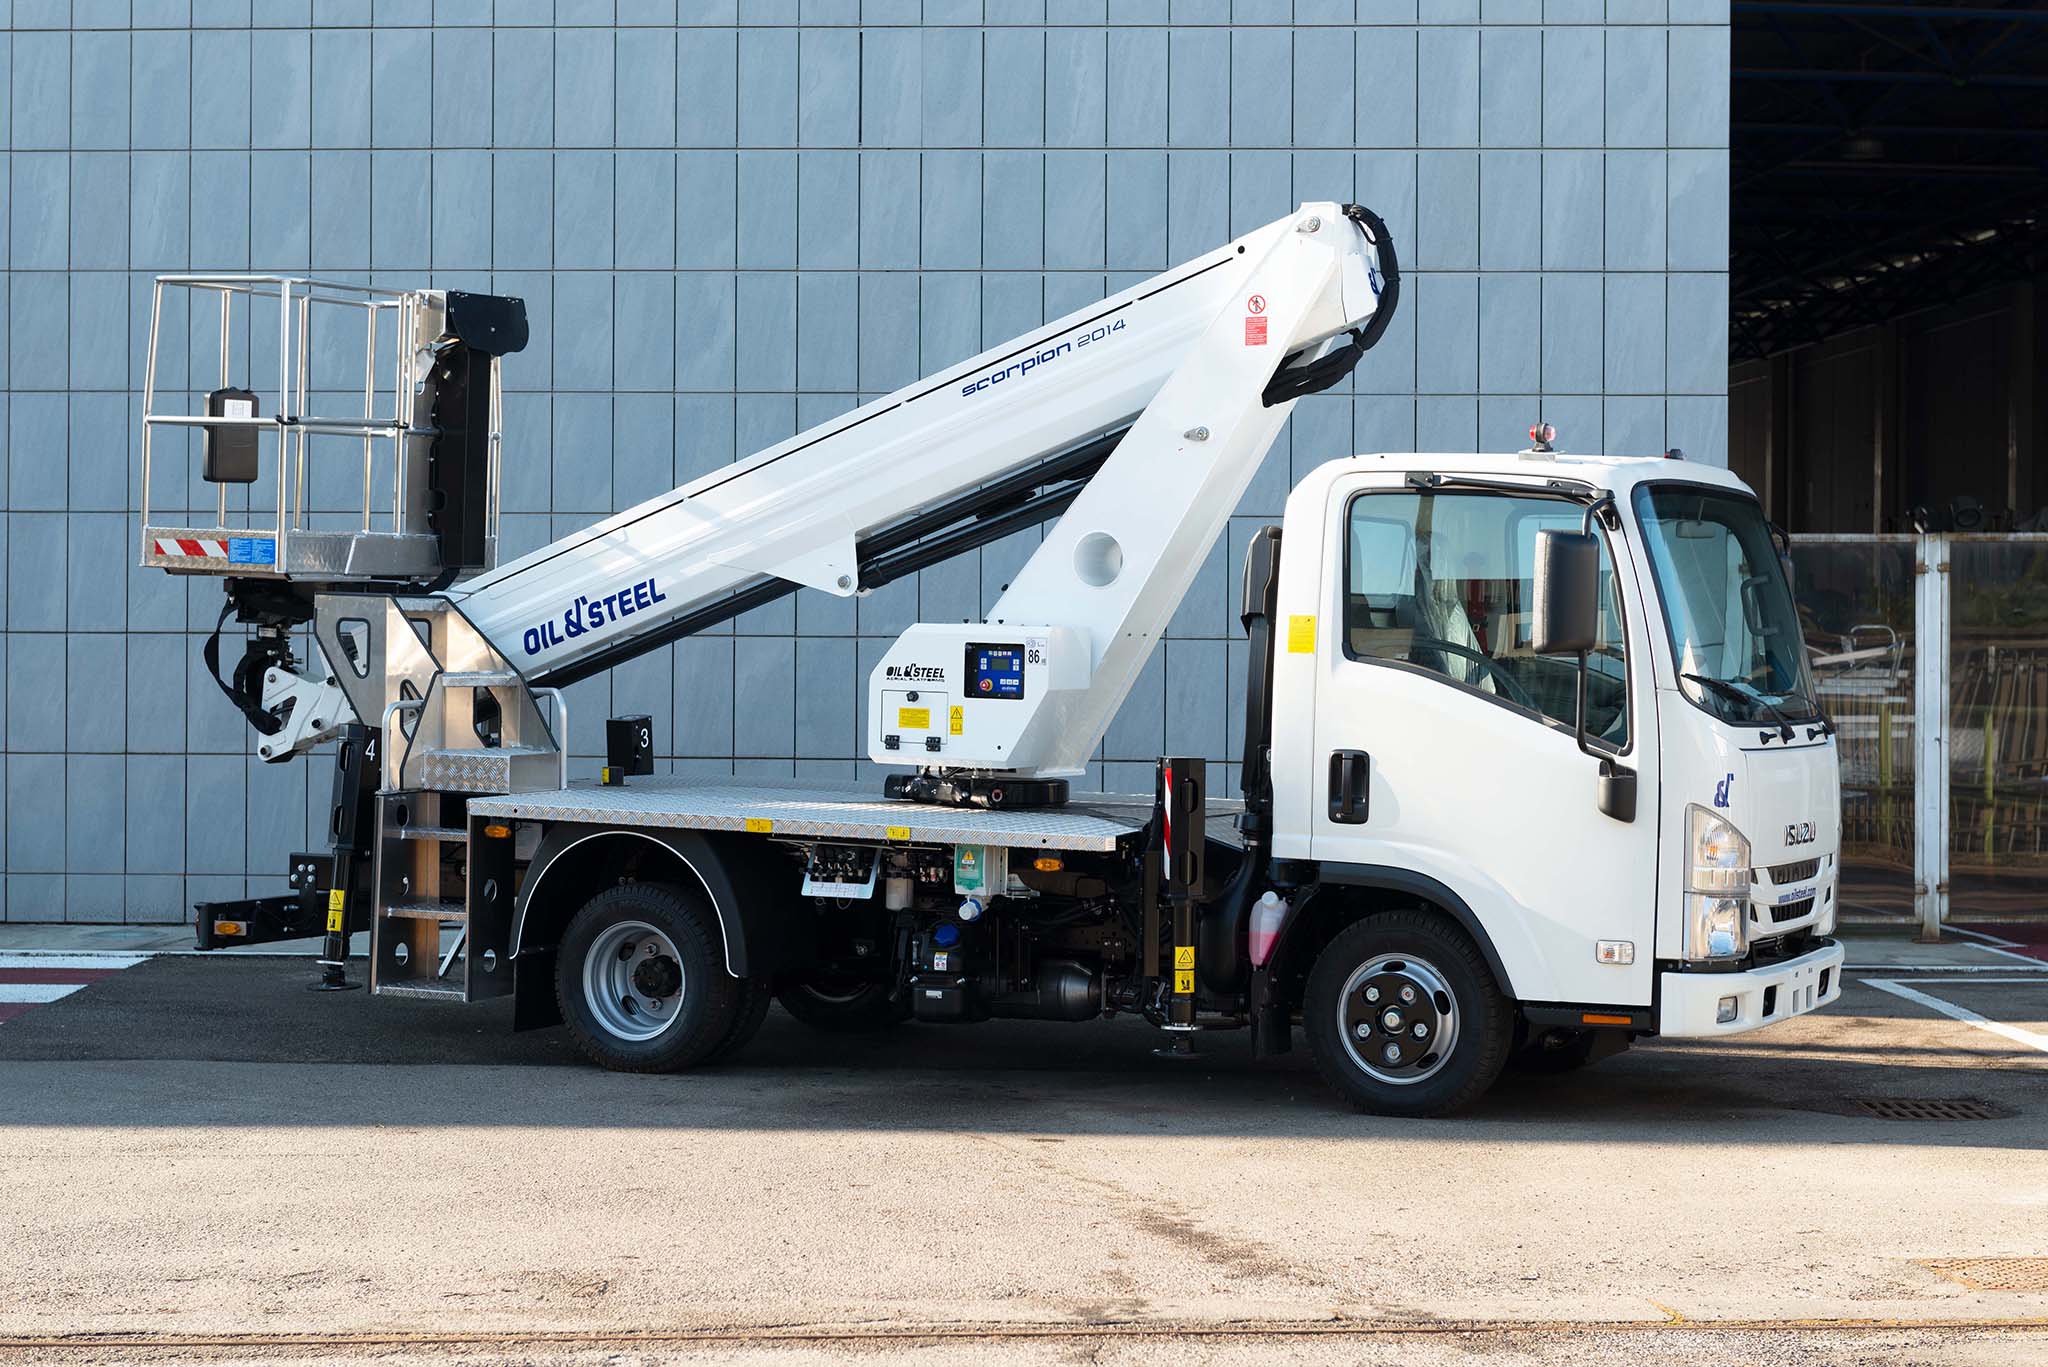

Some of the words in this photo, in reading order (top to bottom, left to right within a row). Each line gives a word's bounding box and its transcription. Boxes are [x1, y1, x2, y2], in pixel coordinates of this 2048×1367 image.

[961, 341, 1072, 398] scorpion
[1076, 318, 1127, 349] 2014
[1028, 649, 1040, 664] 86
[640, 727, 649, 748] 3
[365, 739, 376, 761] 4
[1784, 821, 1817, 847] ISUZU
